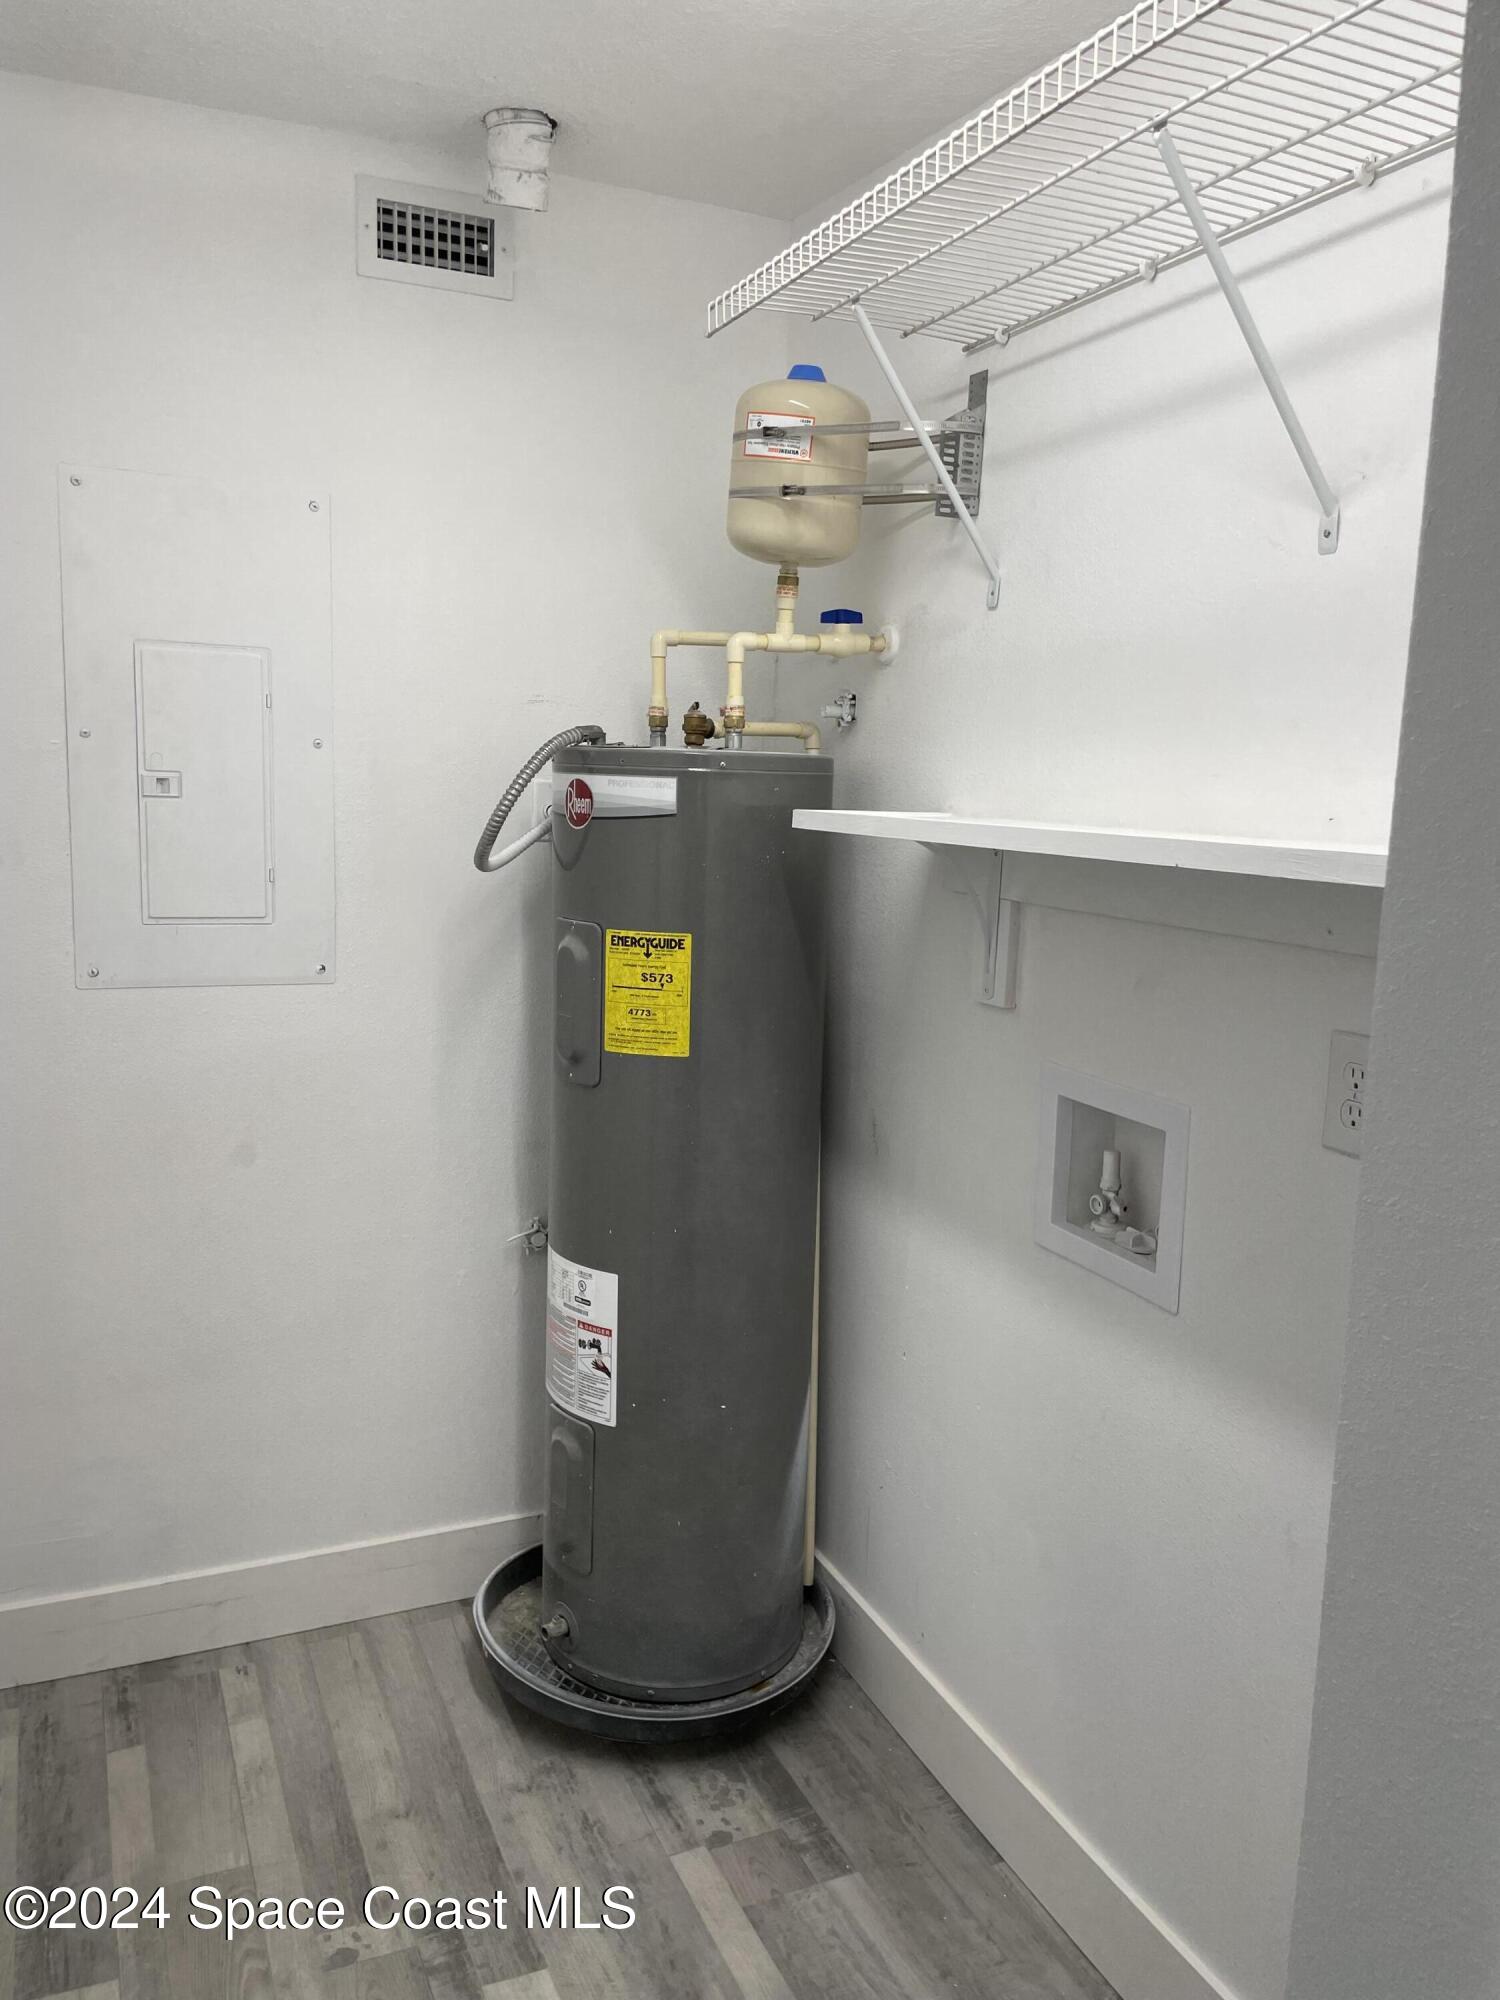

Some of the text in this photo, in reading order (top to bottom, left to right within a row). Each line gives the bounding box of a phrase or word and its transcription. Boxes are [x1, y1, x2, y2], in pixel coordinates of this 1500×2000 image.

[567, 779, 592, 820] Rheem
[641, 972, 673, 983] $573
[628, 1008, 651, 1017] 4773
[584, 1324, 610, 1336] DANGER
